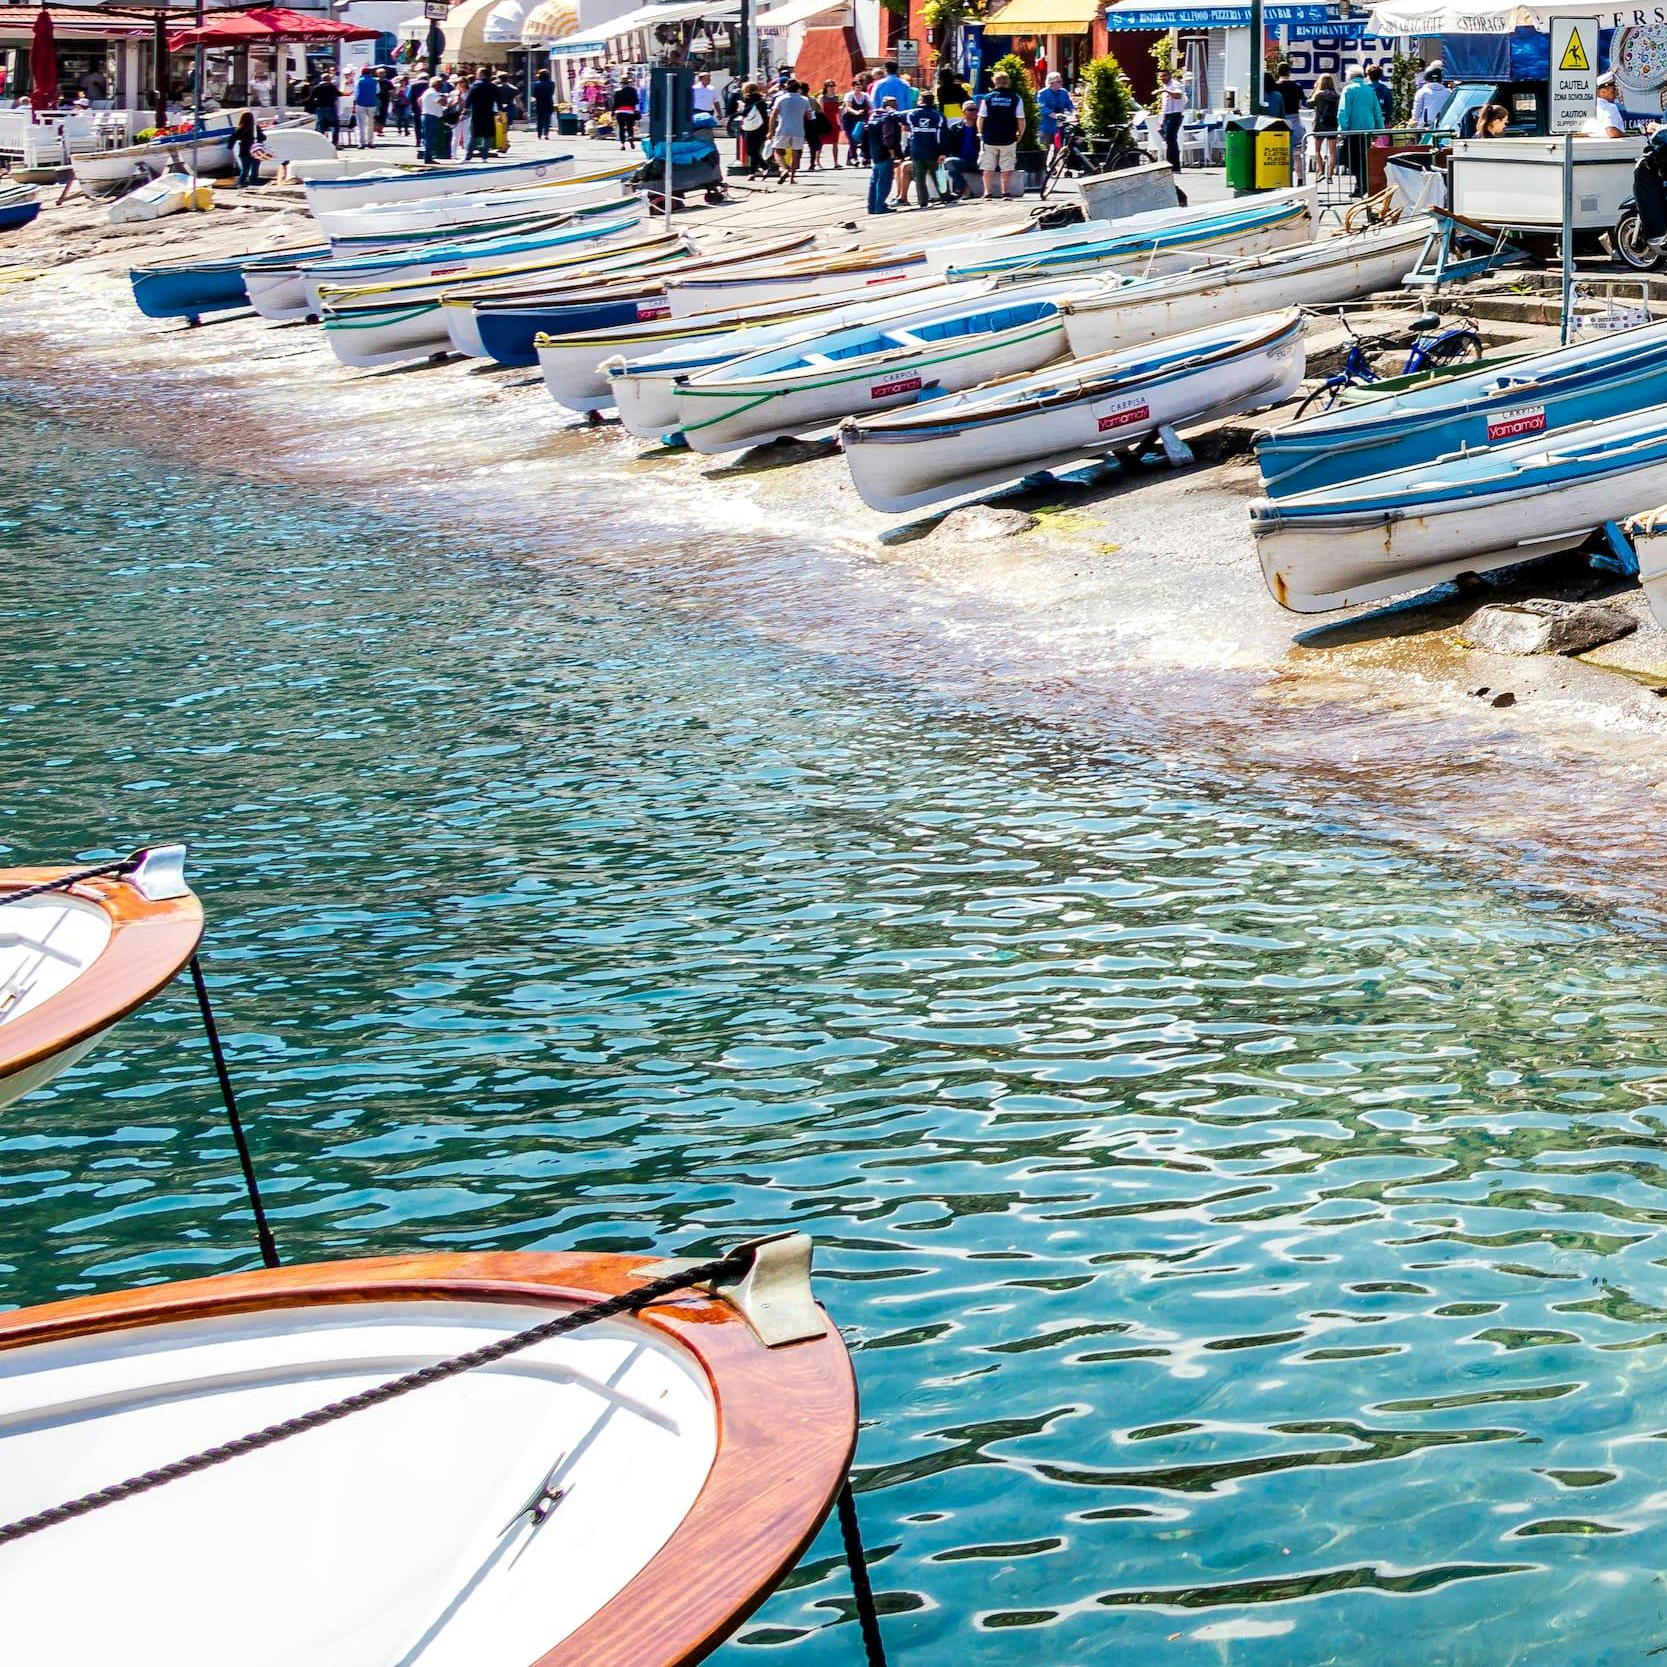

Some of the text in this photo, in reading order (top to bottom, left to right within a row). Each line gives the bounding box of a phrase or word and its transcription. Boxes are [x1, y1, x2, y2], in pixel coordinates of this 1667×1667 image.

[1296, 23, 1350, 36] RISTORANTE
[1560, 80, 1590, 90] CAUTELA
[1554, 93, 1567, 101] ZONA
[1561, 110, 1588, 118] CAUTION
[884, 369, 919, 382] CARPISA
[1111, 397, 1146, 413] CARPISA
[1098, 408, 1149, 431] yamamay
[1489, 415, 1546, 438] yamamay
